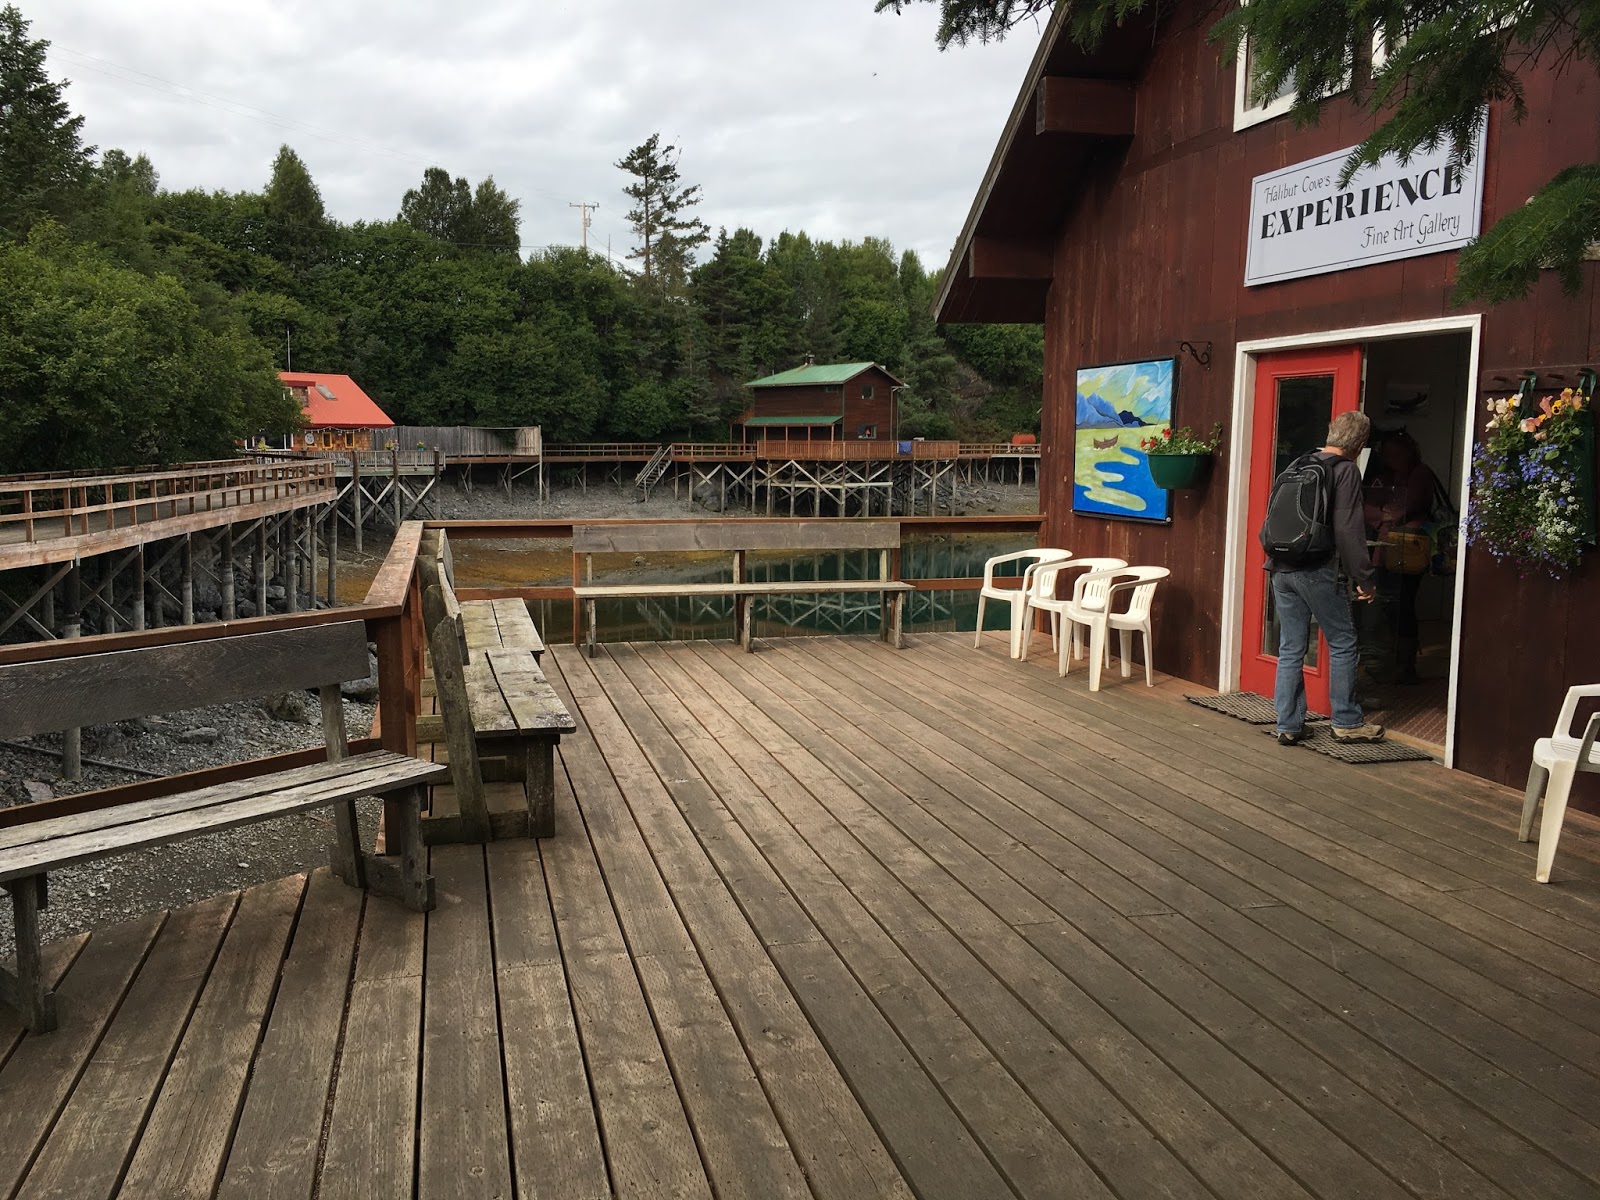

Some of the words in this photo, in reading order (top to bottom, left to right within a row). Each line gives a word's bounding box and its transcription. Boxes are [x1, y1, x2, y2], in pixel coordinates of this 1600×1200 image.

[1260, 165, 1463, 240] EXPERIENCE
[1263, 183, 1299, 203] Halibut
[1302, 175, 1331, 193] Cove's
[1360, 226, 1390, 249] Fine
[1393, 219, 1414, 241] Art
[1416, 212, 1461, 244] Gallery
